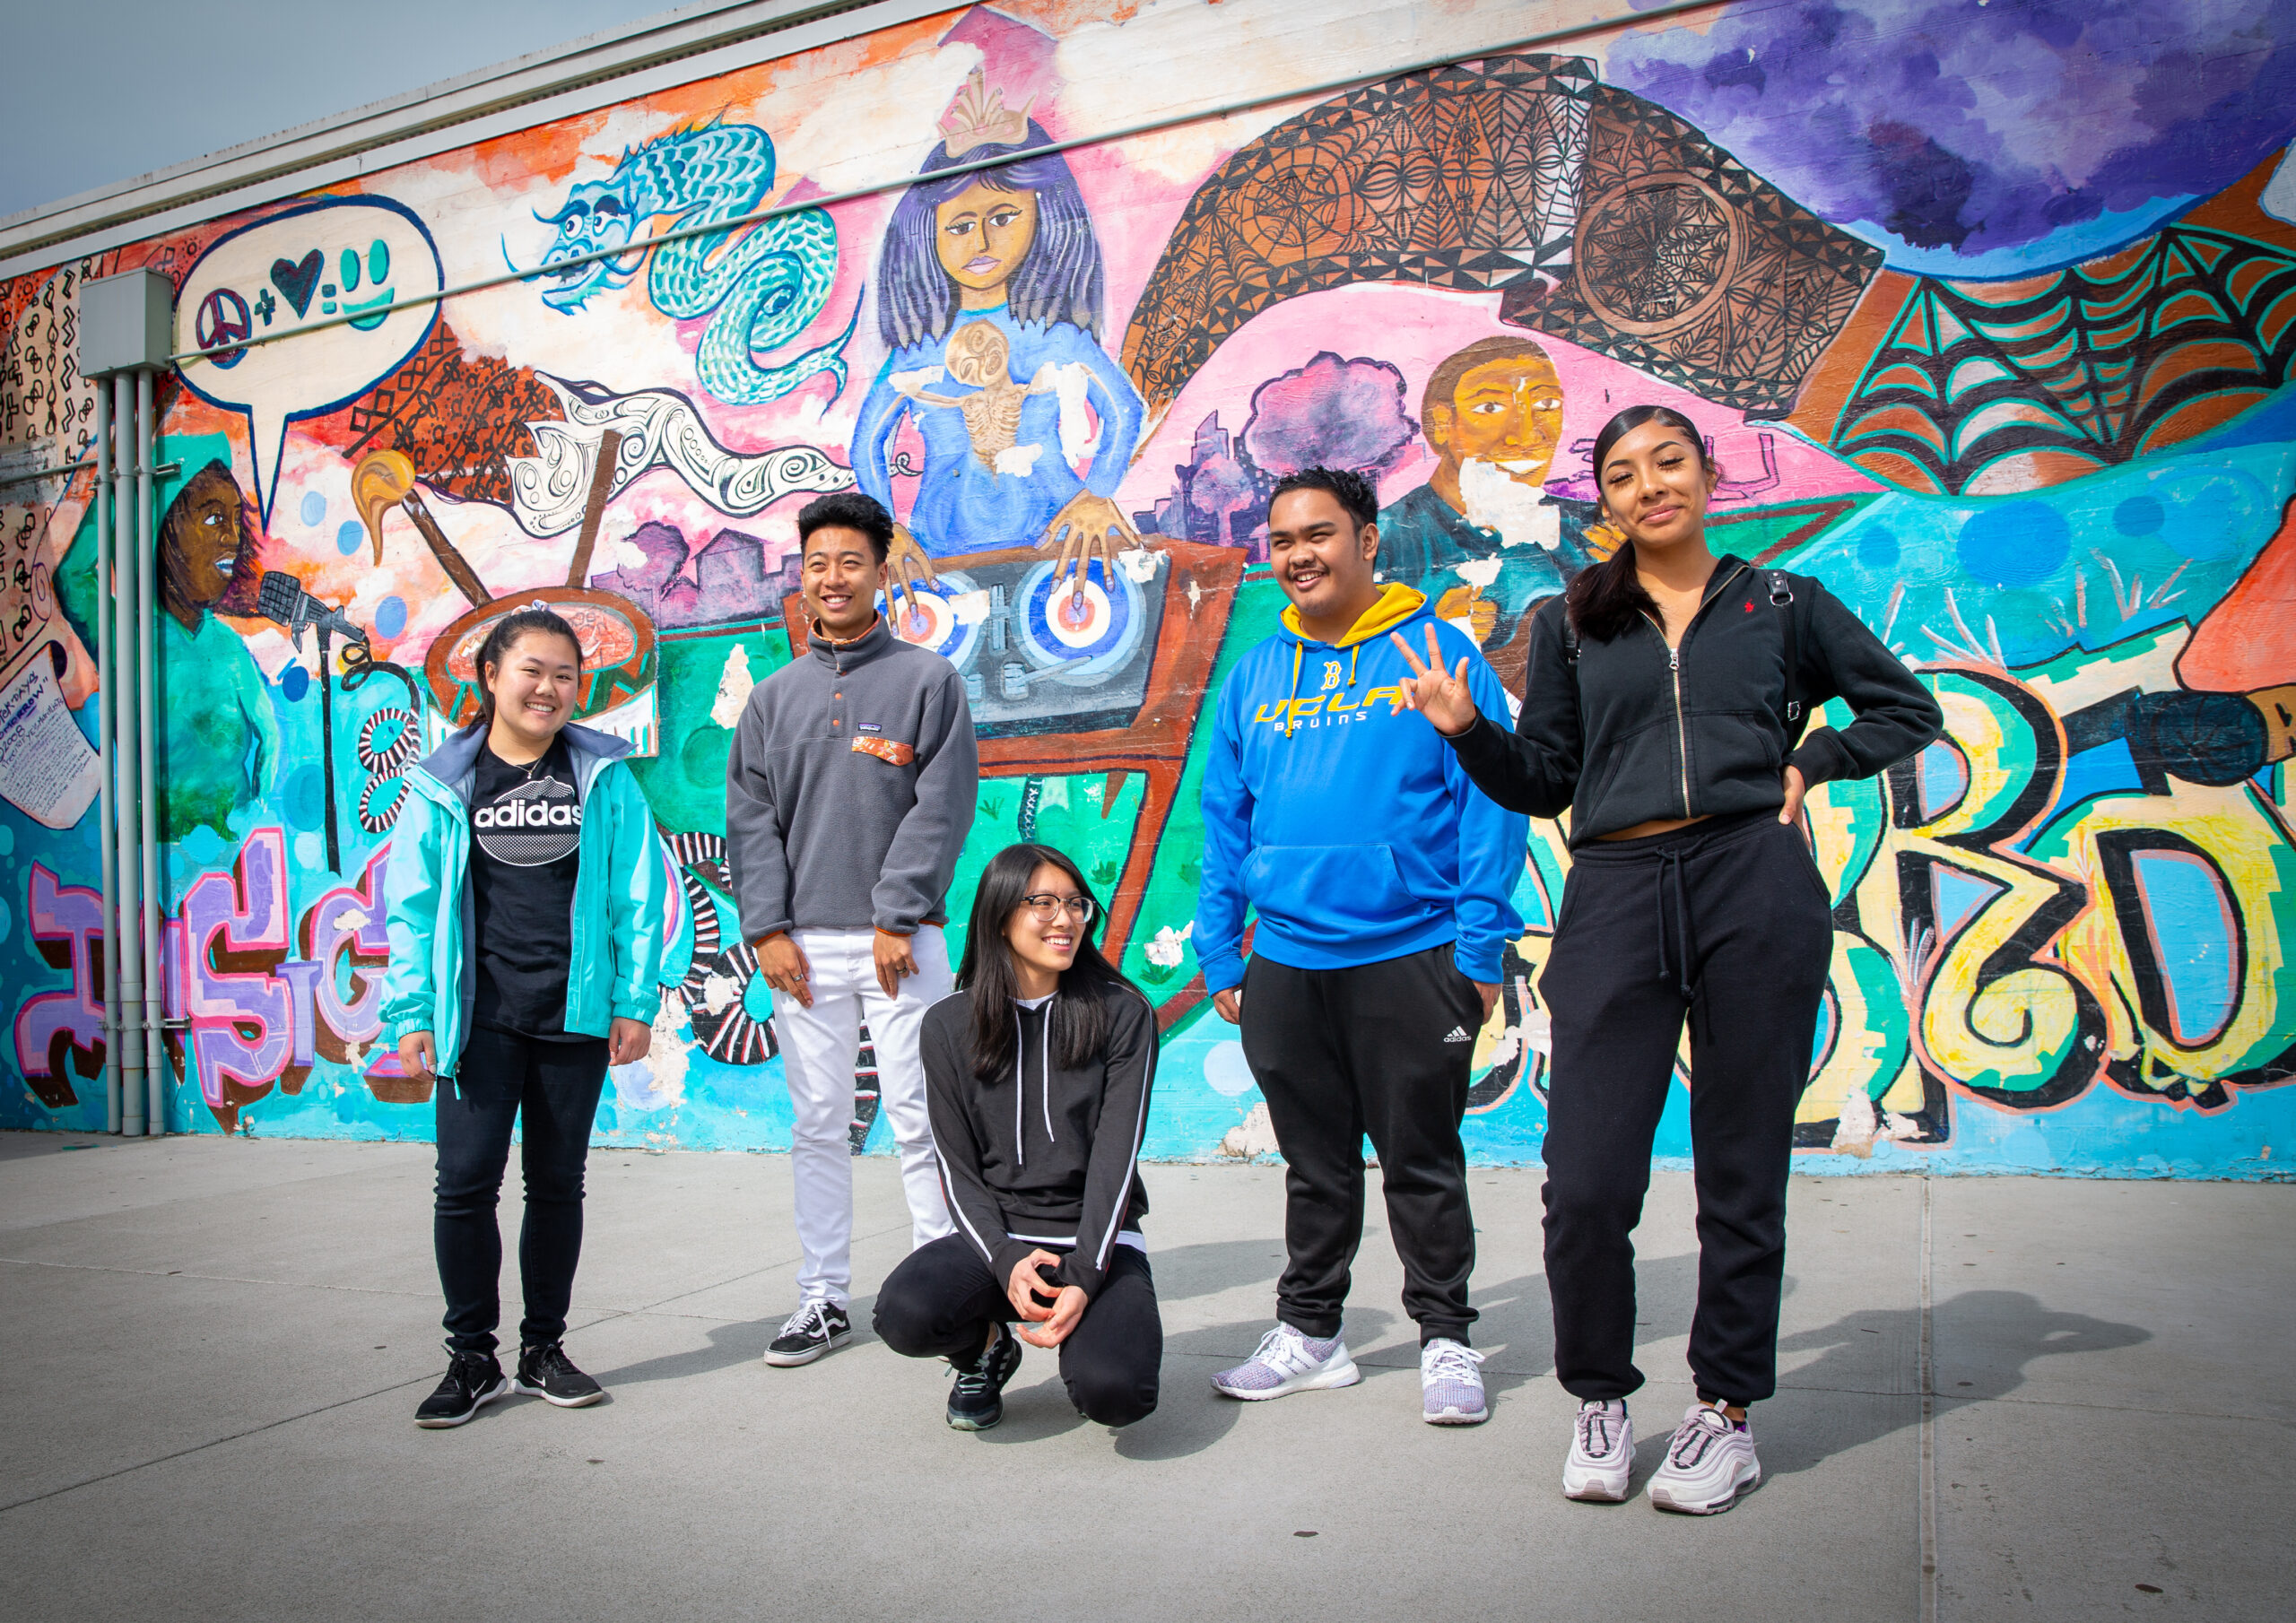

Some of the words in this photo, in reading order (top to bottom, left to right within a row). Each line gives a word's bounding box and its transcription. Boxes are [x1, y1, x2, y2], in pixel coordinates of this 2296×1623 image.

[1320, 661, 1342, 690] B
[1254, 686, 1403, 723] UCLA
[474, 799, 581, 828] adidas
